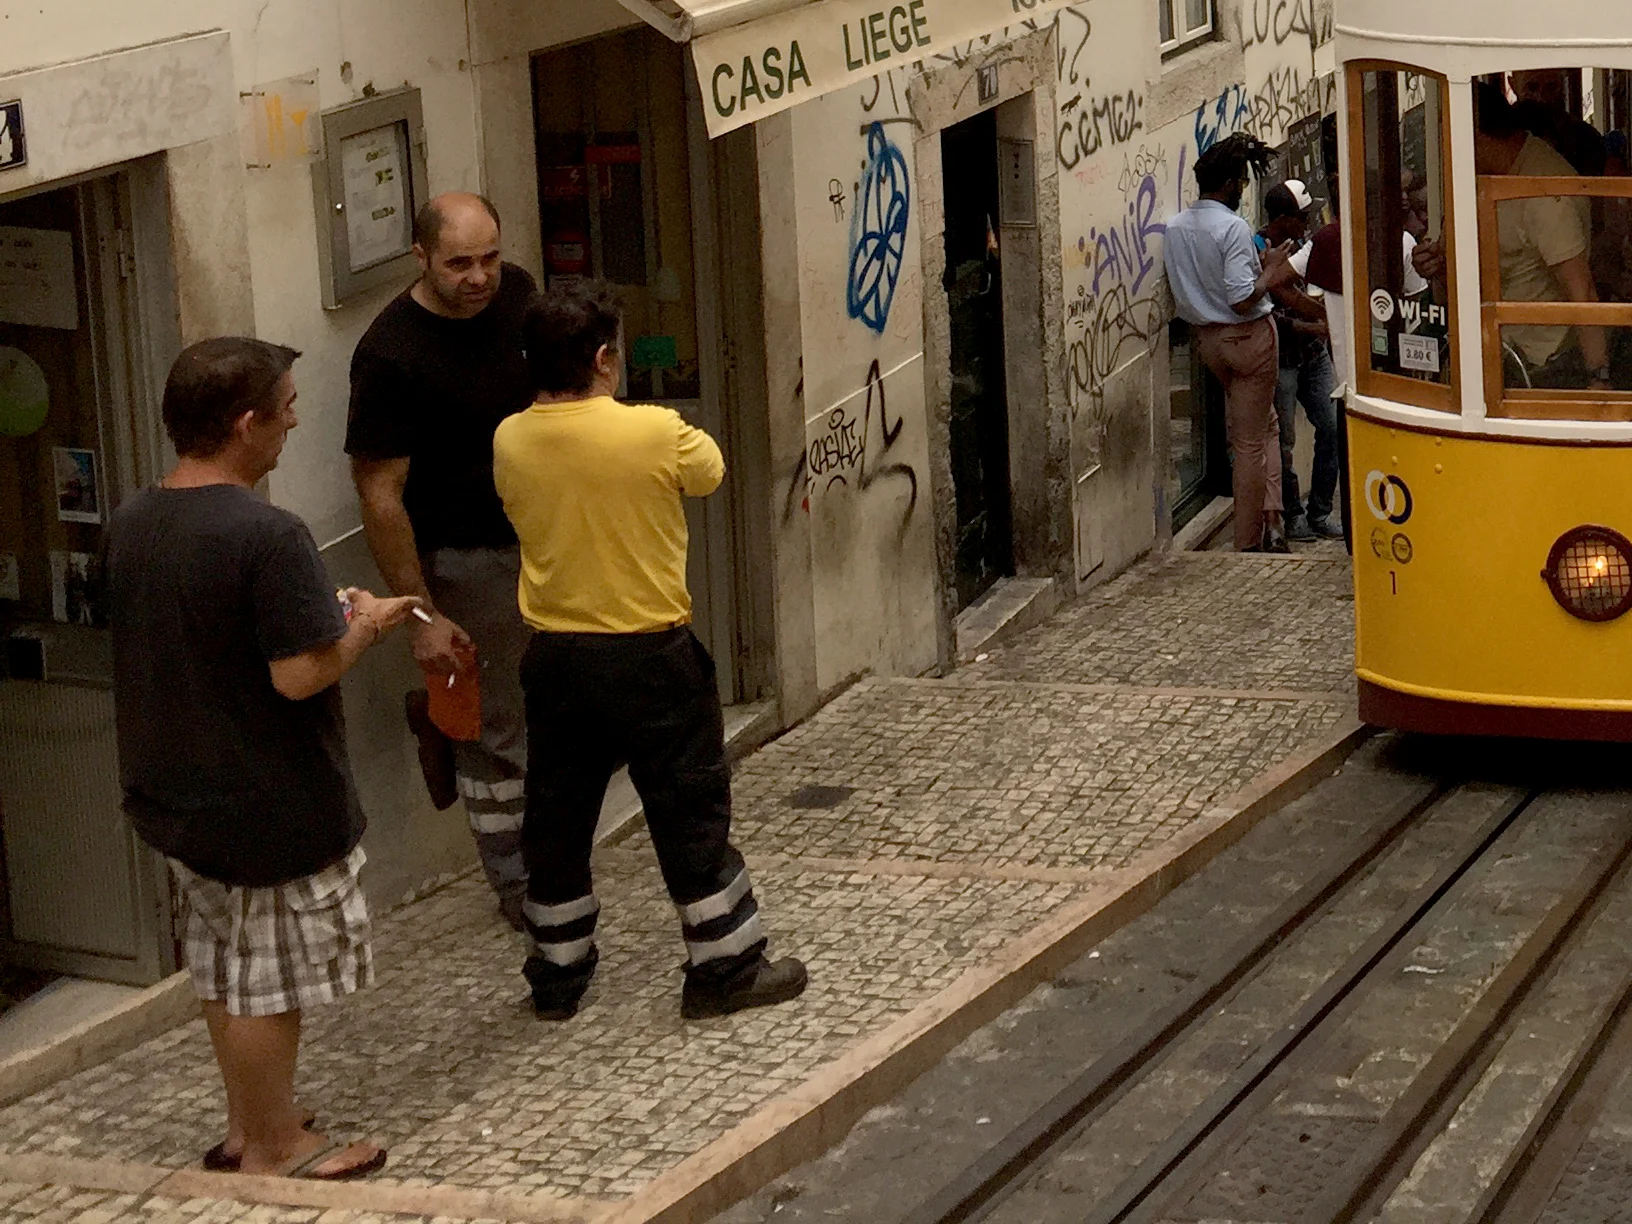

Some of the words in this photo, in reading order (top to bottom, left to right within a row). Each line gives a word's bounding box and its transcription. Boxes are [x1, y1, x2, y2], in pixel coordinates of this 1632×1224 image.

[712, 40, 812, 117] CASA
[842, 0, 931, 71] LIEGE
[1398, 298, 1446, 327] WI-FI
[1389, 570, 1397, 595] 1
